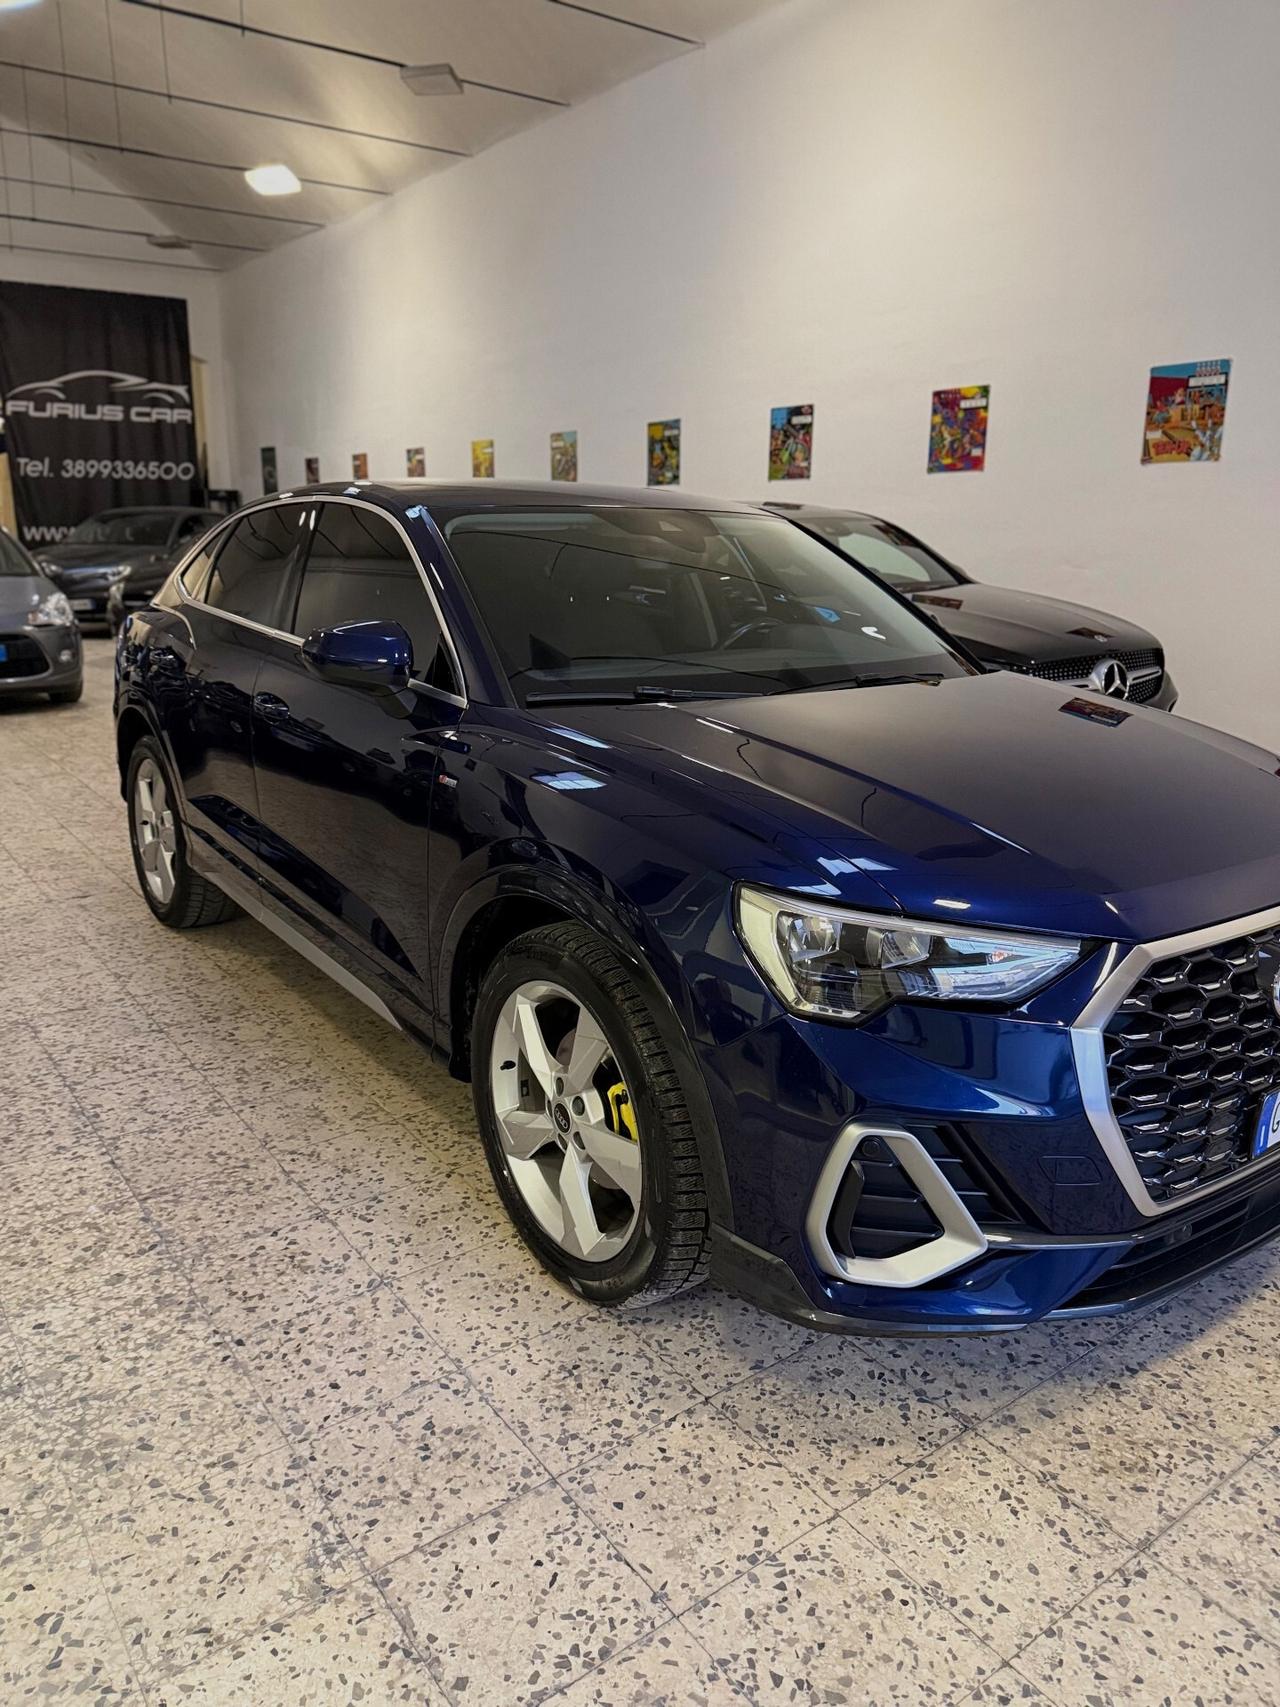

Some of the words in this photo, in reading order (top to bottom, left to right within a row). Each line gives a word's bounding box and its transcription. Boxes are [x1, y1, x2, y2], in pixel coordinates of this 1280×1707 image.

[6, 400, 124, 421] FURIUS
[130, 406, 192, 424] CAR
[16, 457, 54, 477] Tel.
[61, 459, 195, 480] 3899336500
